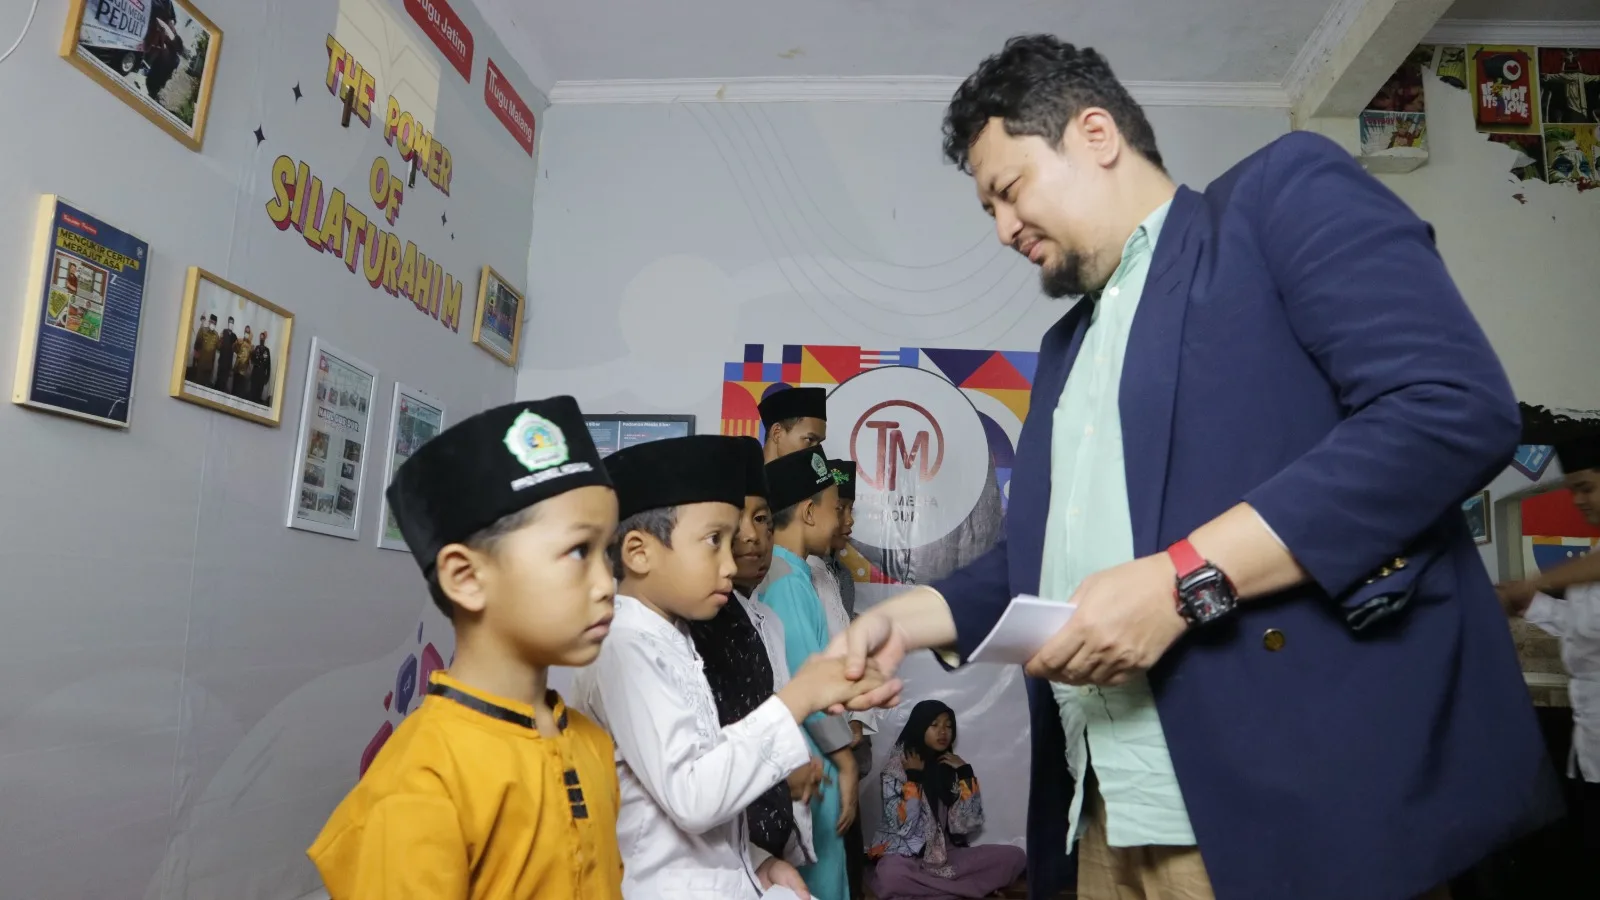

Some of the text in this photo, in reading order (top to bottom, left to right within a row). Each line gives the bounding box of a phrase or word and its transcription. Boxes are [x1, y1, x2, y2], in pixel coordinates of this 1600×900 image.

[95, 0, 145, 37] PEDULI
[417, 0, 441, 25] ugu
[440, 17, 467, 58] Jatim
[326, 33, 375, 128] THE
[488, 65, 510, 110] Tugu
[508, 99, 533, 143] Malang
[1502, 85, 1527, 101] NOT
[1504, 100, 1528, 117] LOVE
[384, 95, 452, 196] POWER
[369, 156, 404, 226] OF
[60, 229, 106, 253] MENGUKIR
[62, 240, 121, 270] MERAJUT ASA
[265, 155, 463, 333] SILATURAHIM
